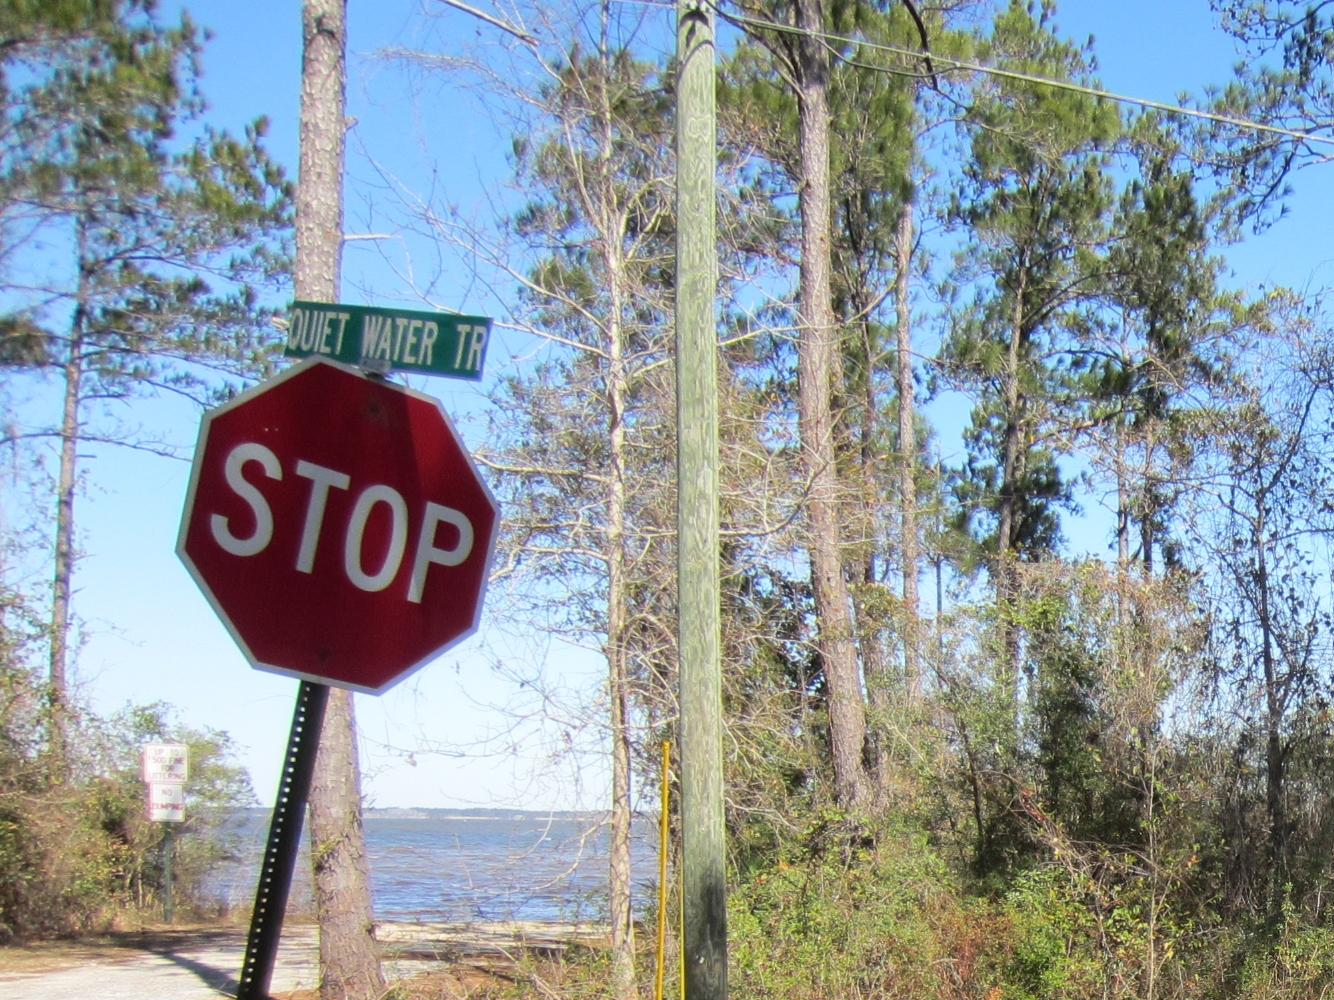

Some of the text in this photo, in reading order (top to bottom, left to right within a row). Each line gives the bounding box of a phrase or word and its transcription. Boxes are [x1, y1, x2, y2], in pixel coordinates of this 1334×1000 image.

[288, 307, 488, 371] QUIET WATER TR
[210, 442, 474, 604] STOP
